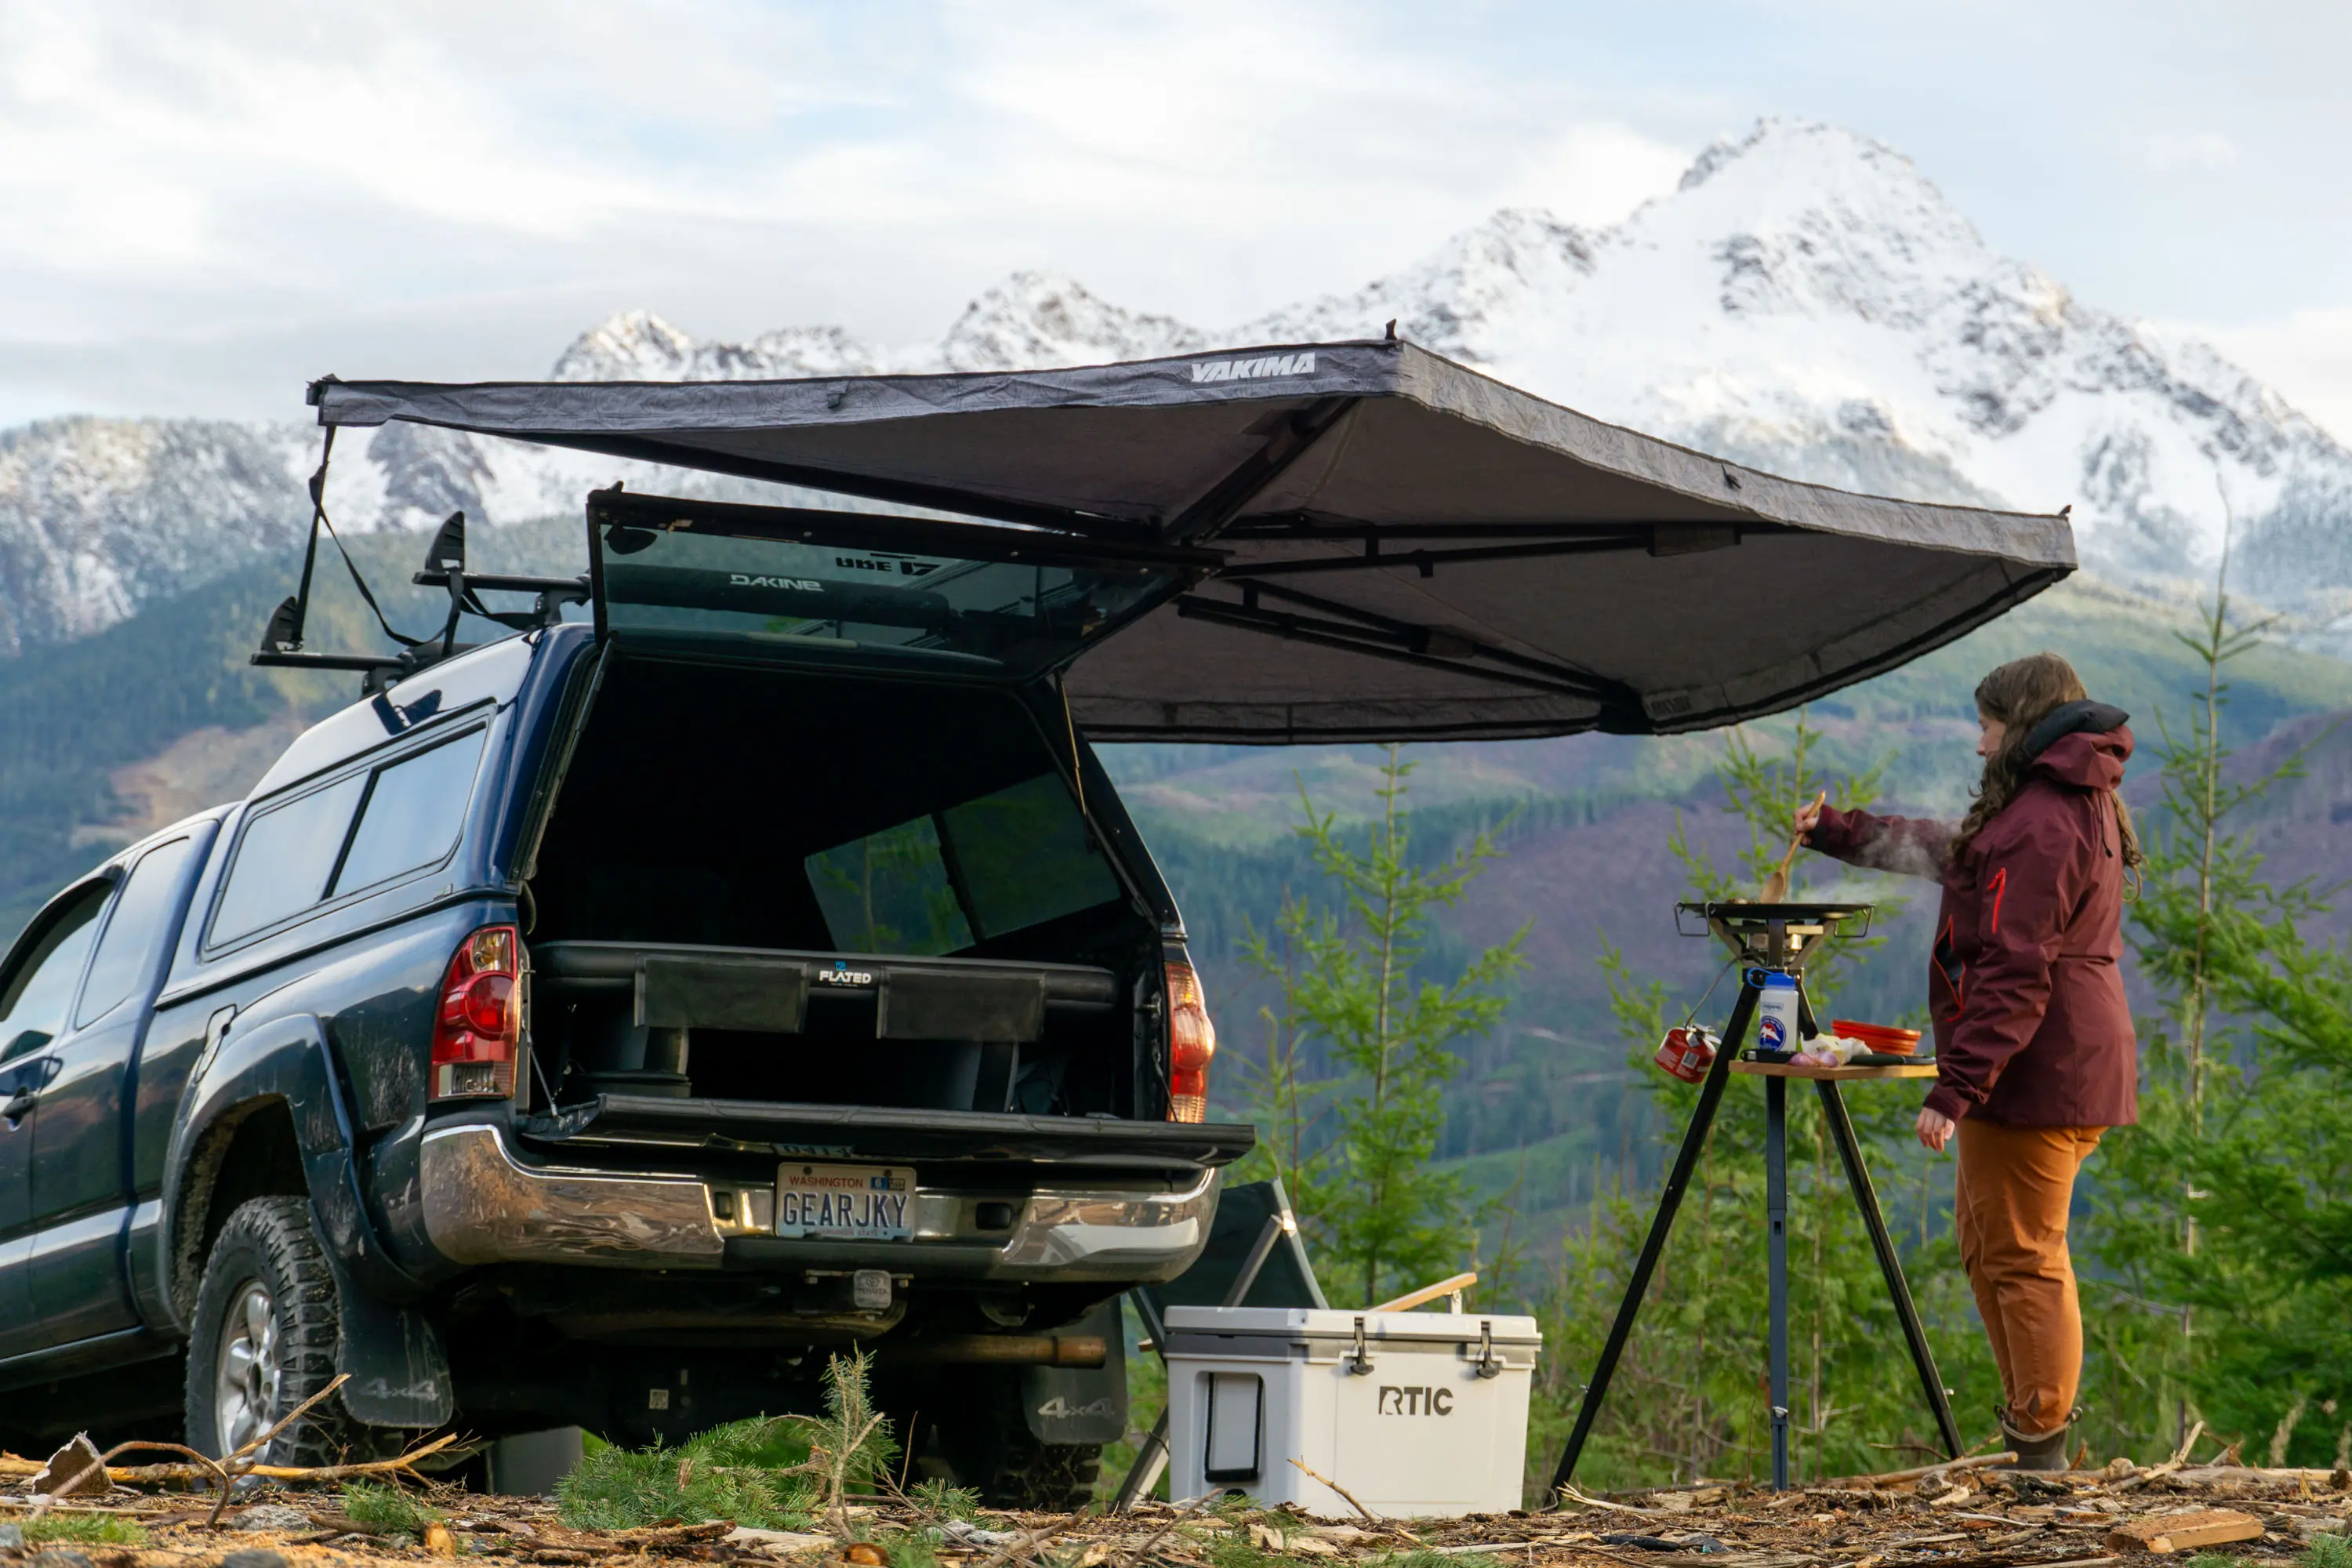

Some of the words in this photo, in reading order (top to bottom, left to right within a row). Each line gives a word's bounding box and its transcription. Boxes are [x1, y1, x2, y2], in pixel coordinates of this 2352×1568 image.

[1191, 352, 1316, 383] YAKIMA
[819, 970, 872, 984] FLATED
[789, 1176, 863, 1189] WASHINGTON
[784, 1192, 909, 1229] GEARJKY
[1378, 1385, 1454, 1416] RTIC
